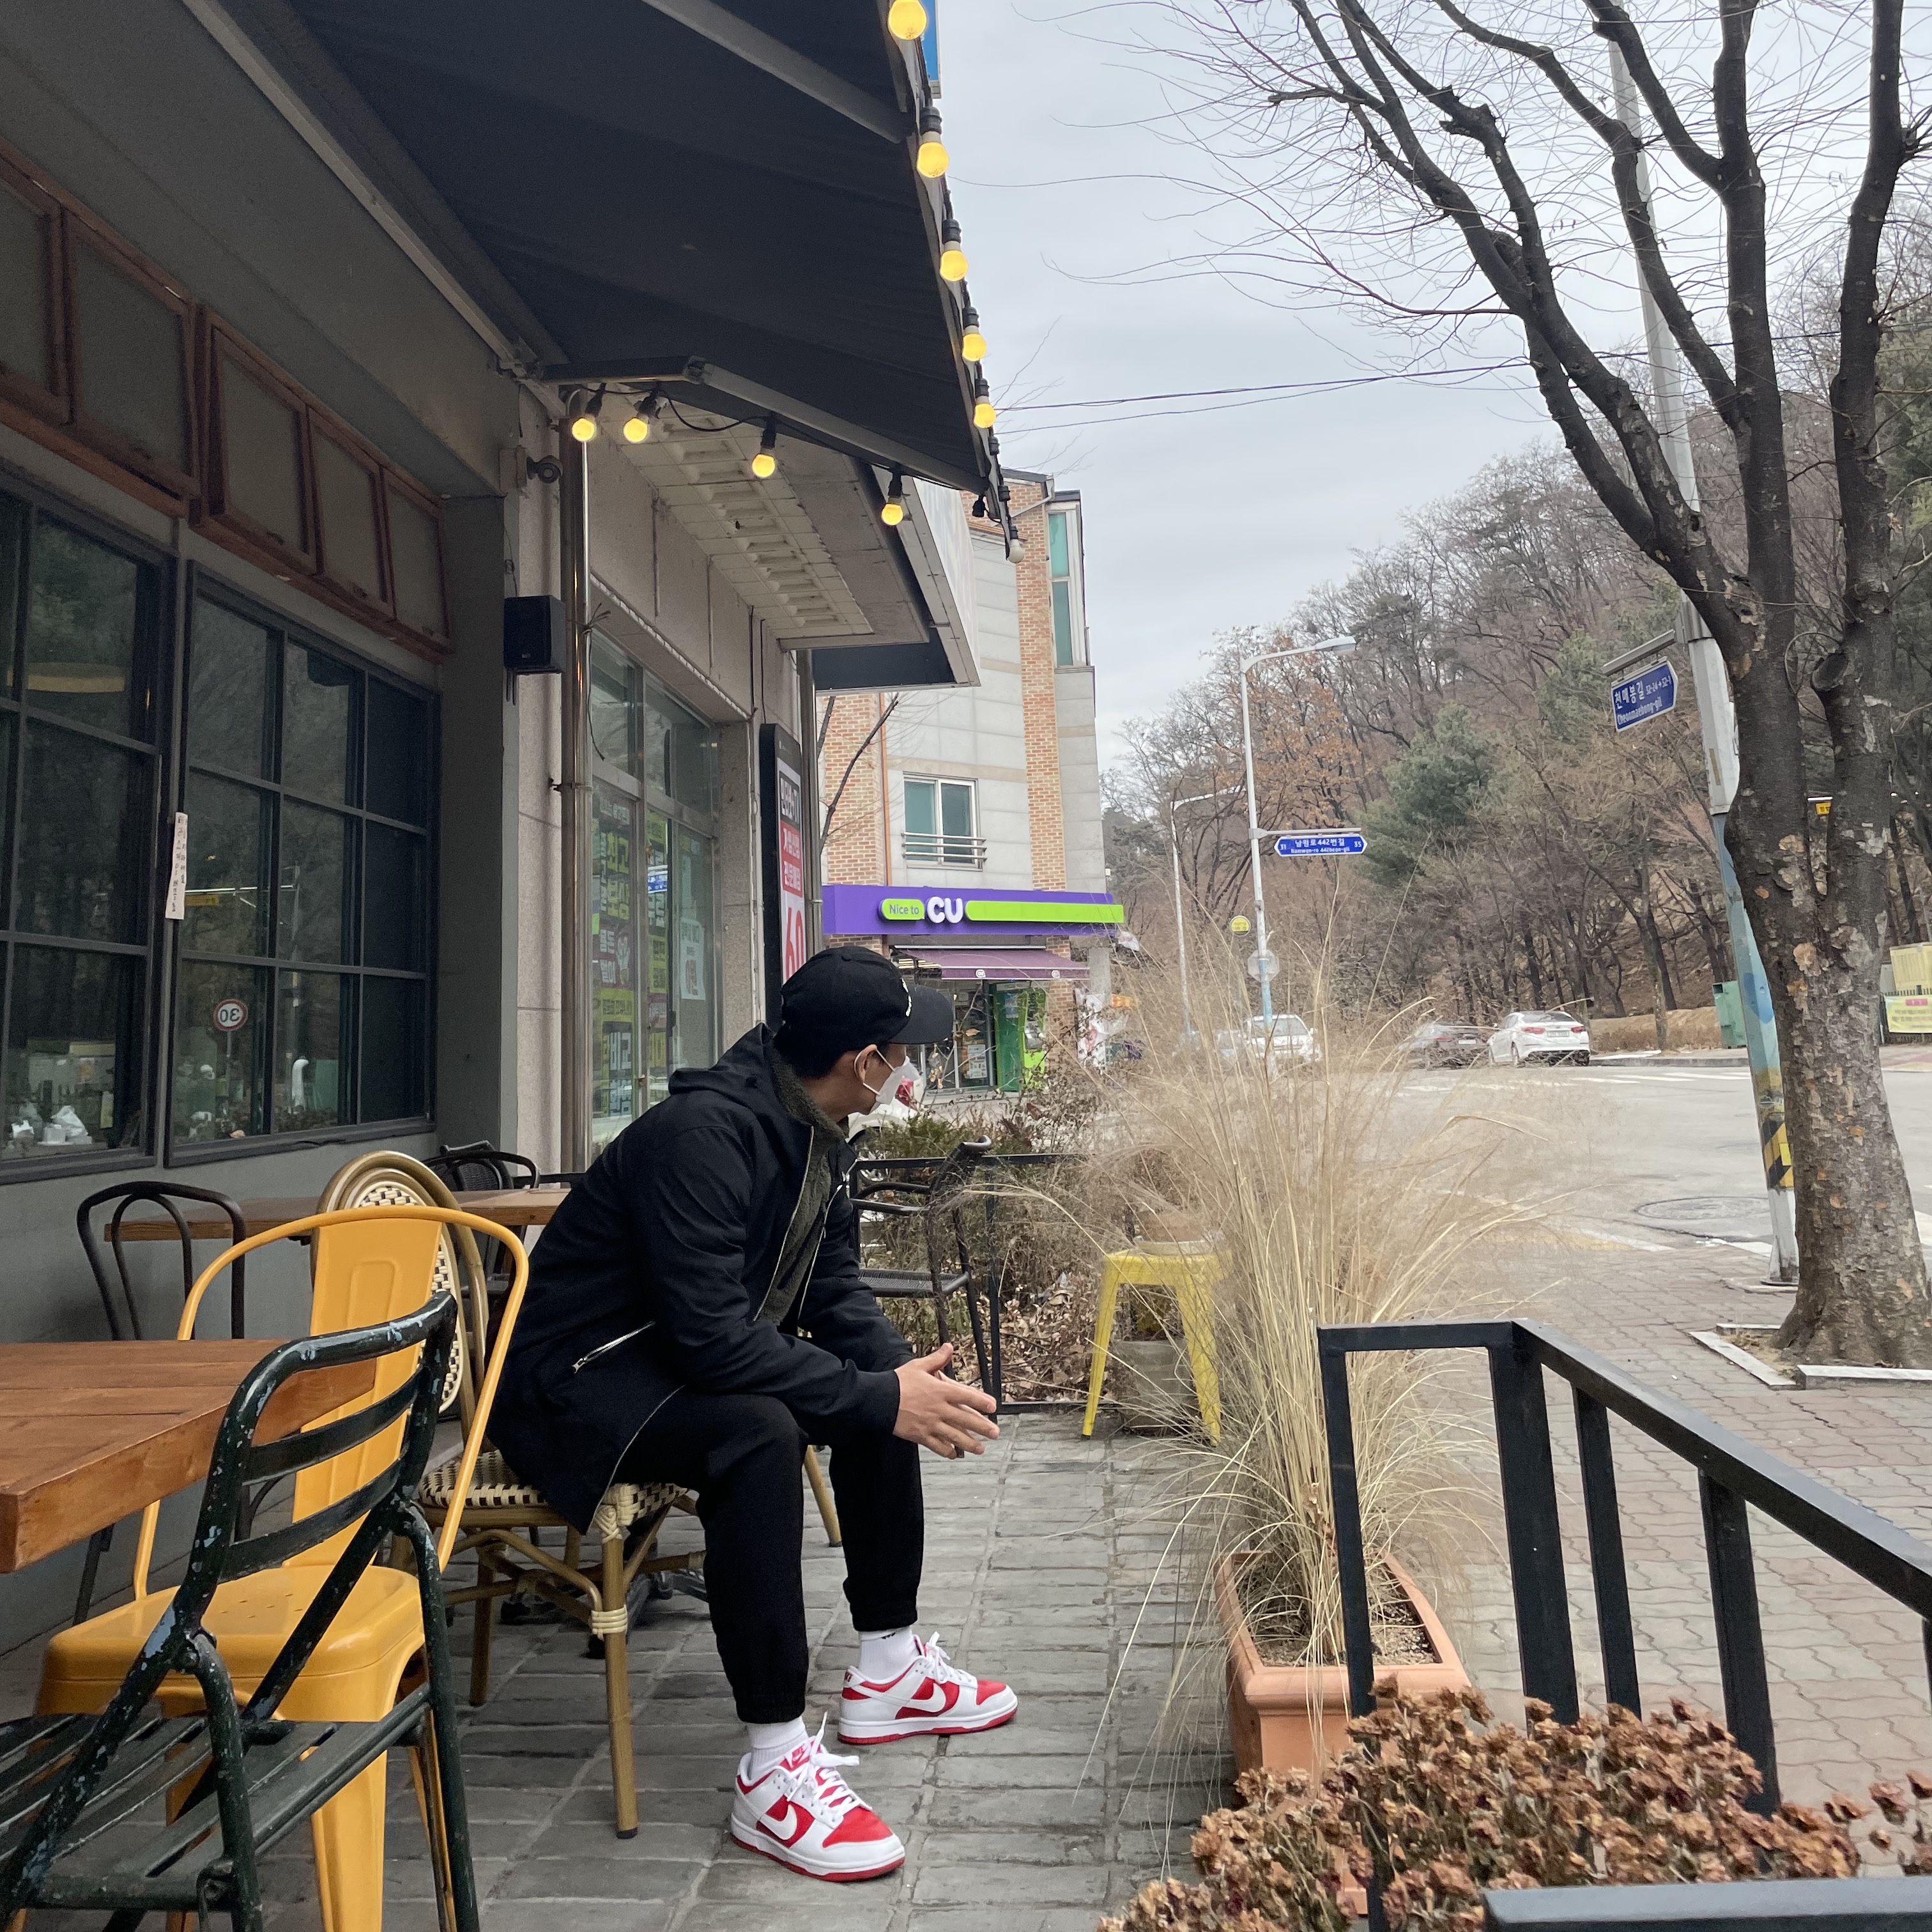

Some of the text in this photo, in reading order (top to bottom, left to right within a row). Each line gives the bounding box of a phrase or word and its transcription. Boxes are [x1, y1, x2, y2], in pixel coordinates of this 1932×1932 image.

[889, 896, 963, 924] Nice to CU
